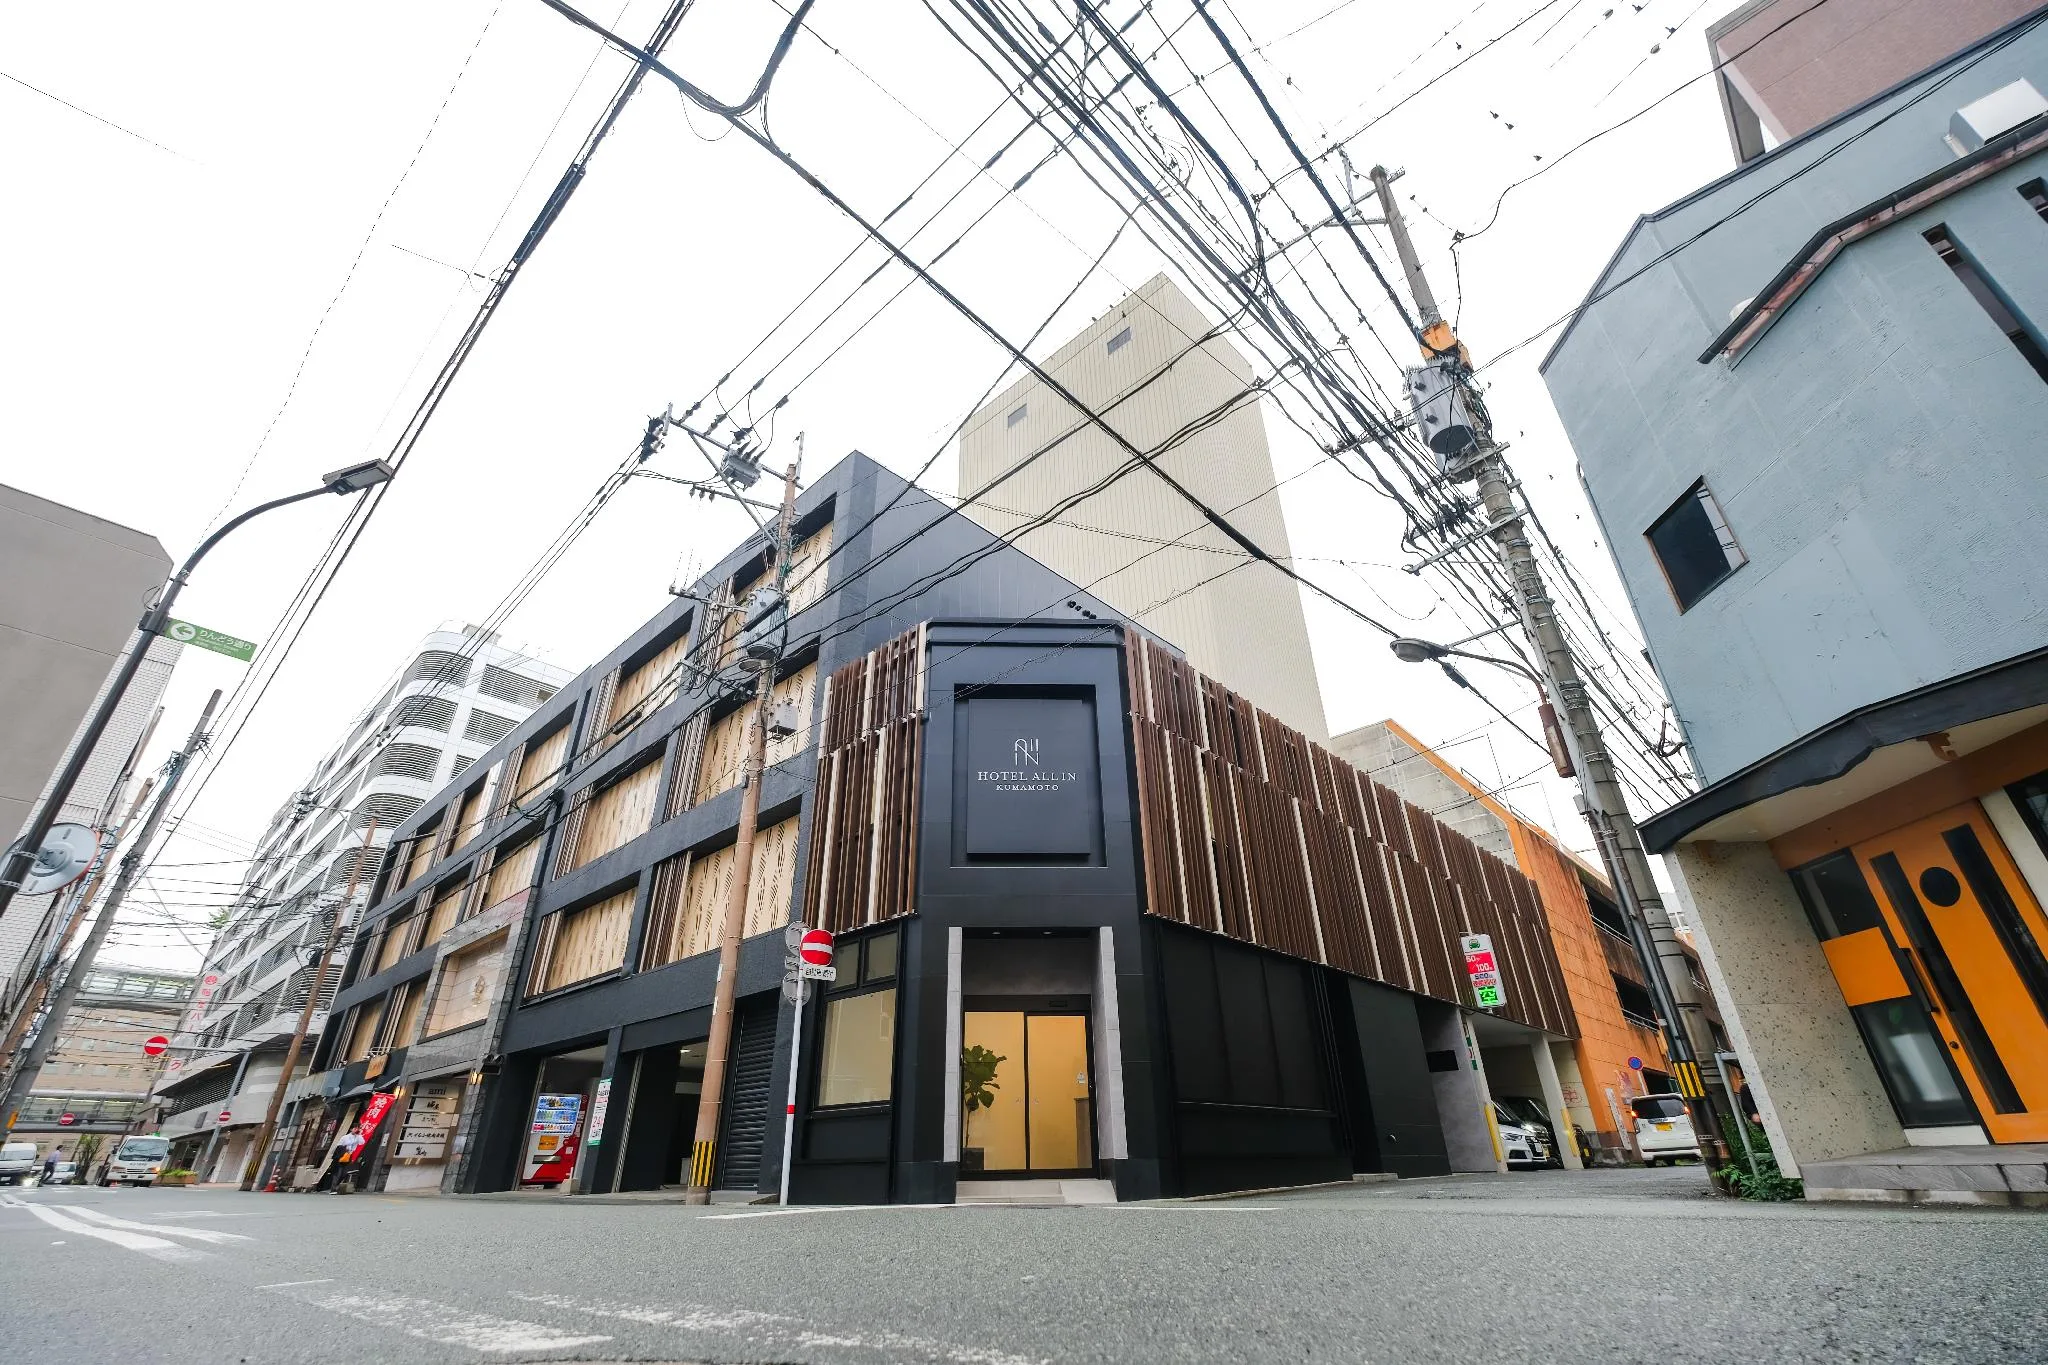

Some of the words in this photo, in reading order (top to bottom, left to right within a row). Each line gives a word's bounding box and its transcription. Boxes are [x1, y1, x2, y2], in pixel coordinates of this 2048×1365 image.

[200, 630, 252, 651] りんどう通り
[978, 771, 1028, 781] HOTEL
[428, 1086, 447, 1096] ami
